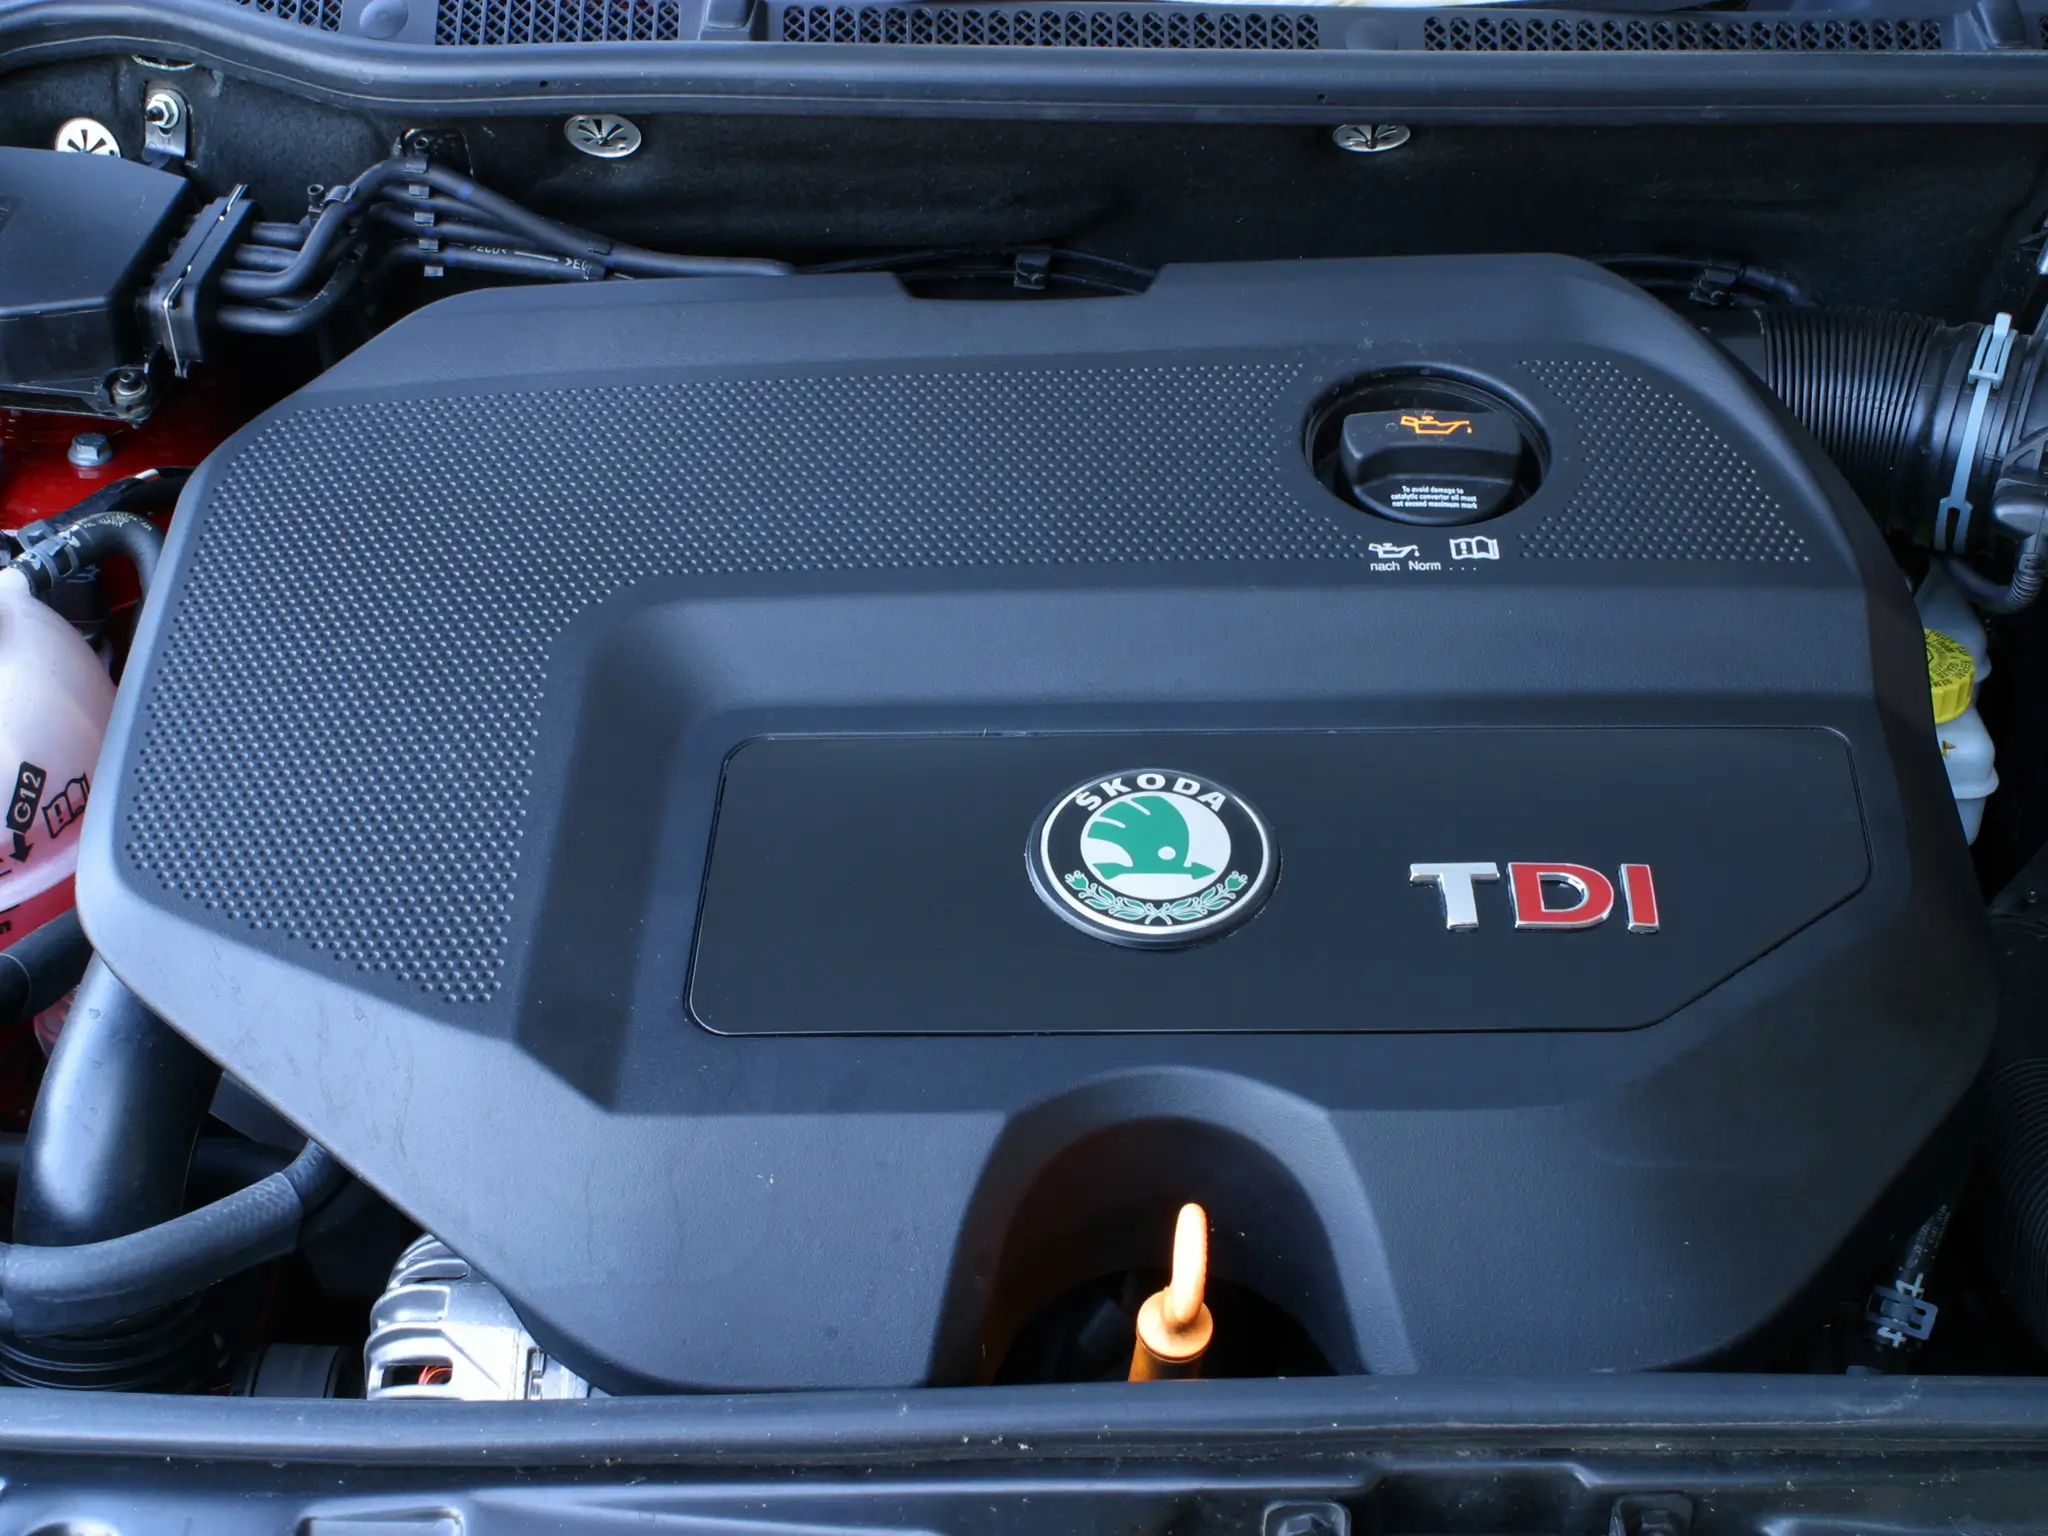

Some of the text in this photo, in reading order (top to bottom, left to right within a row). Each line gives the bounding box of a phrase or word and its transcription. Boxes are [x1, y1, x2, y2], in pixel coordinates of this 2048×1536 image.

[1402, 485, 1410, 493] To
[1430, 486, 1455, 495] damage
[1390, 493, 1418, 501] catalytic
[1370, 560, 1400, 571] nach
[1408, 560, 1441, 571] Norm
[14, 771, 42, 823] G12
[1409, 862, 1660, 932] TDI
